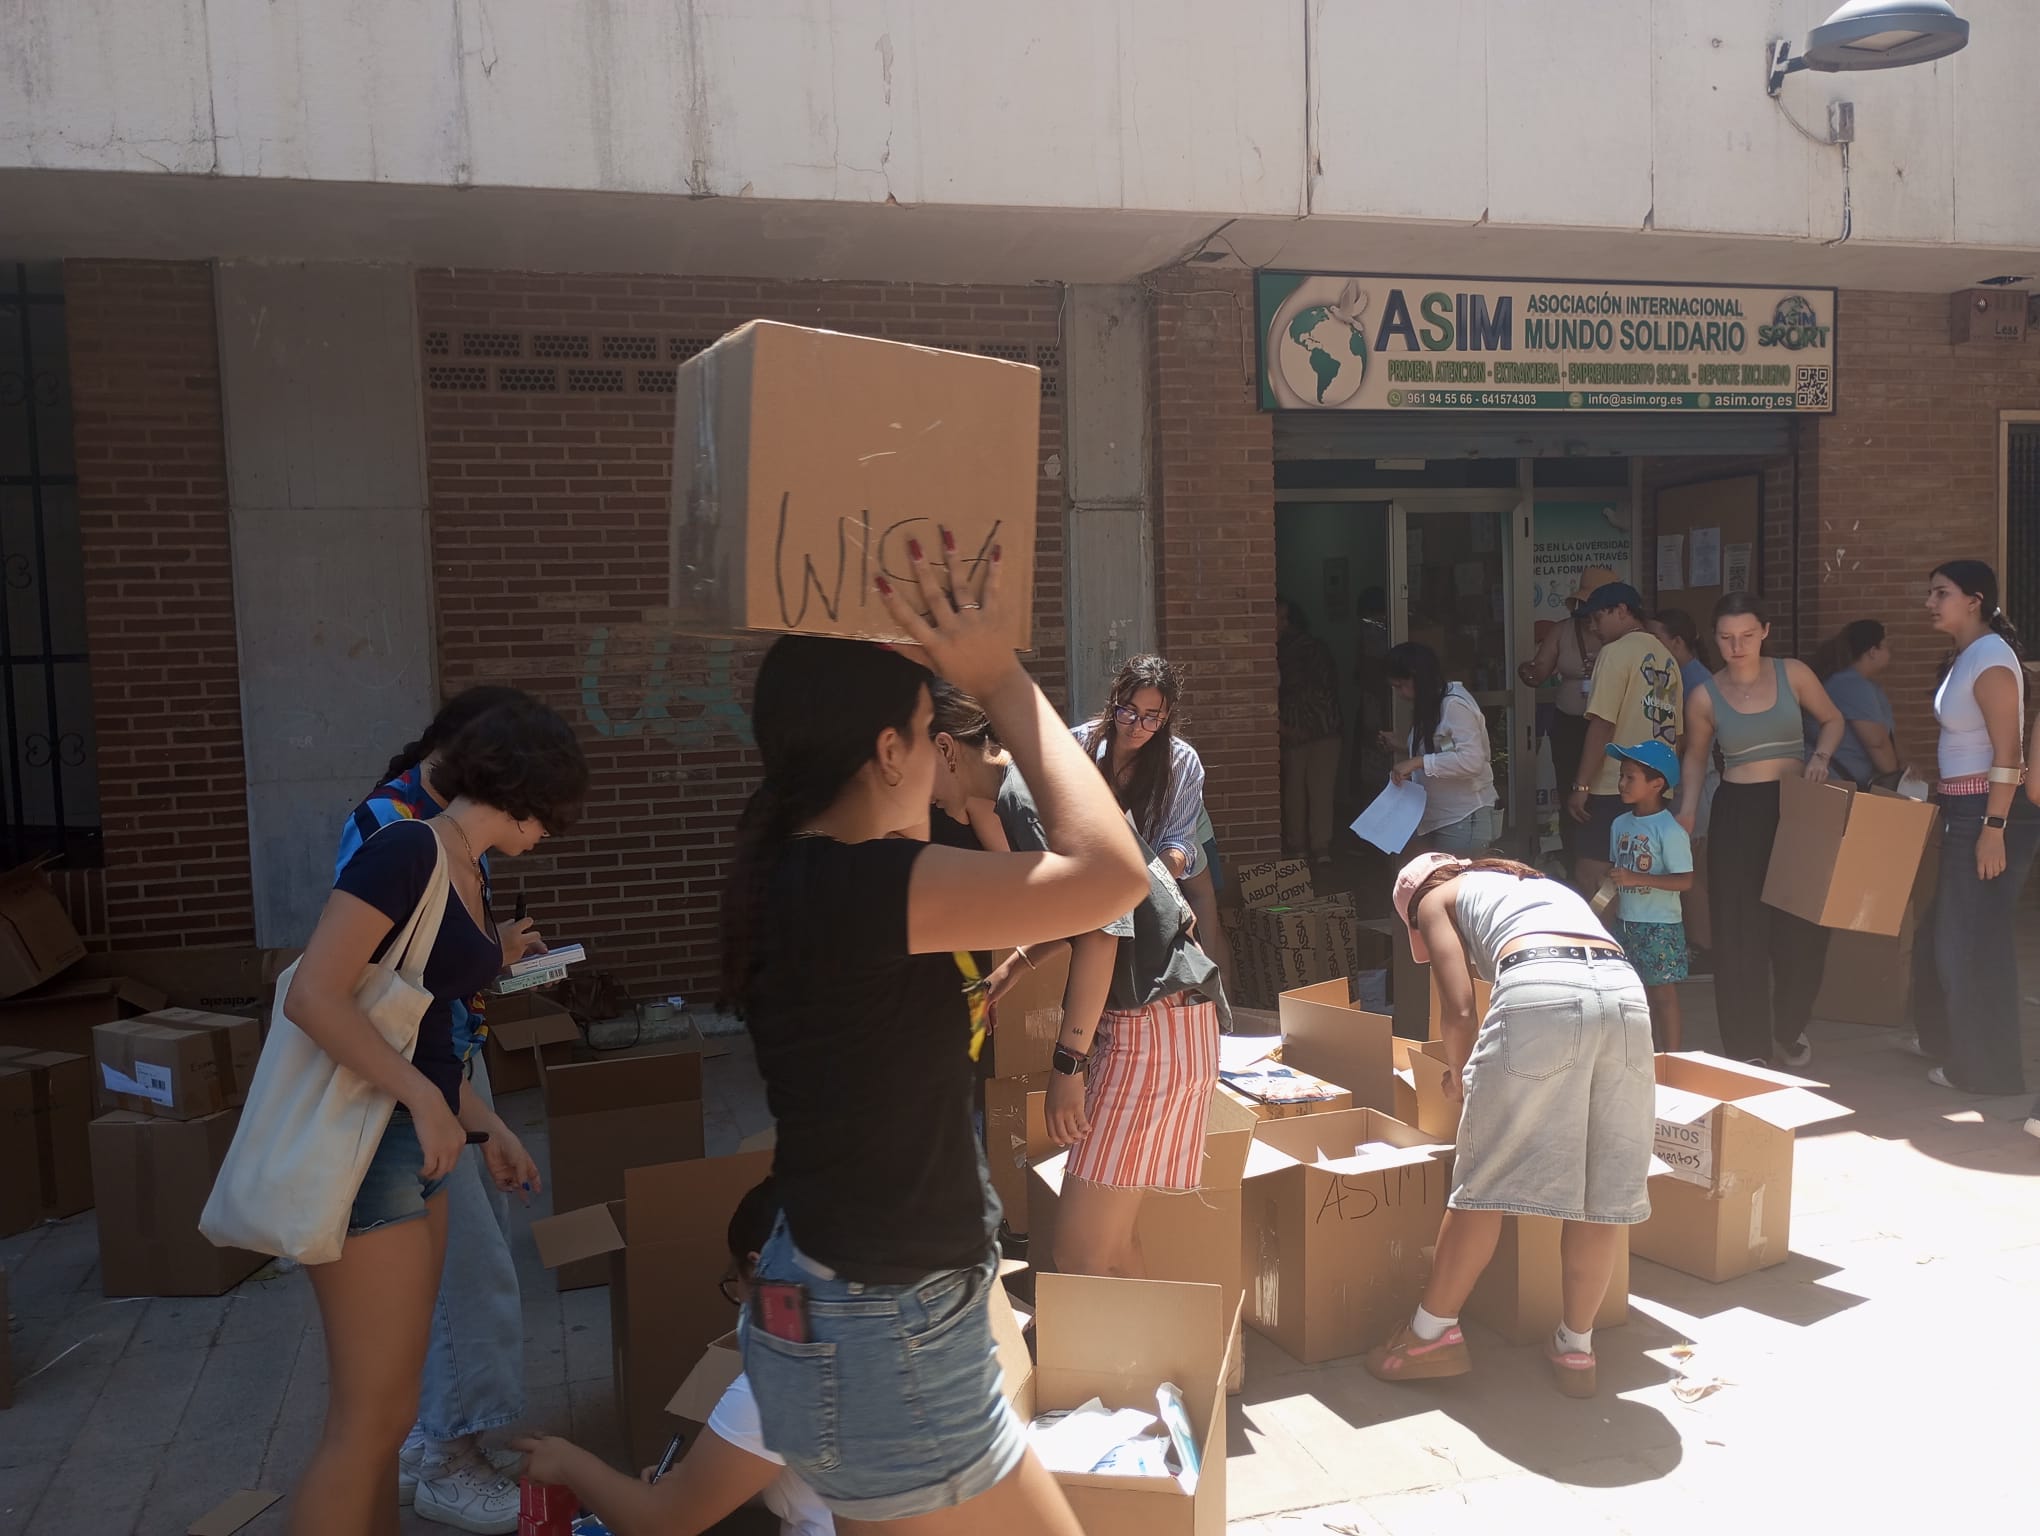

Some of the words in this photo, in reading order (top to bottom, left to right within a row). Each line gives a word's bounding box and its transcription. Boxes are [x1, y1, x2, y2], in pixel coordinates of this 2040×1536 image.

[1527, 291, 1620, 314] ASOCIACIÓN
[1626, 296, 1743, 317] INTERNACIONAL
[1374, 289, 1512, 351] ASIM
[1775, 312, 1816, 327] ASIM
[1525, 318, 1612, 350] MUNDO
[1620, 320, 1744, 351] SOLIDARIO
[1758, 325, 1830, 348] SPORT
[1388, 360, 1434, 381] PRIMERA
[1568, 363, 1655, 384] EMPRENDIMIENTO
[1656, 364, 1690, 384] SOCIAL
[1407, 393, 1425, 405] 961
[1429, 393, 1441, 405] 94
[1445, 394, 1456, 405] 55
[1460, 394, 1472, 405] 66
[1482, 394, 1536, 406] 641574303
[1588, 394, 1683, 407] info@asim.org.es
[1715, 394, 1792, 409] asim.org.es
[1547, 543, 1560, 552] EN
[1562, 542, 1574, 551] LA
[1575, 540, 1630, 551] DIVERSIDAD
[1585, 553, 1592, 561] A
[1594, 552, 1628, 561] TRAVÉS
[1543, 566, 1555, 575] LA
[1316, 1163, 1426, 1224] ASIM
